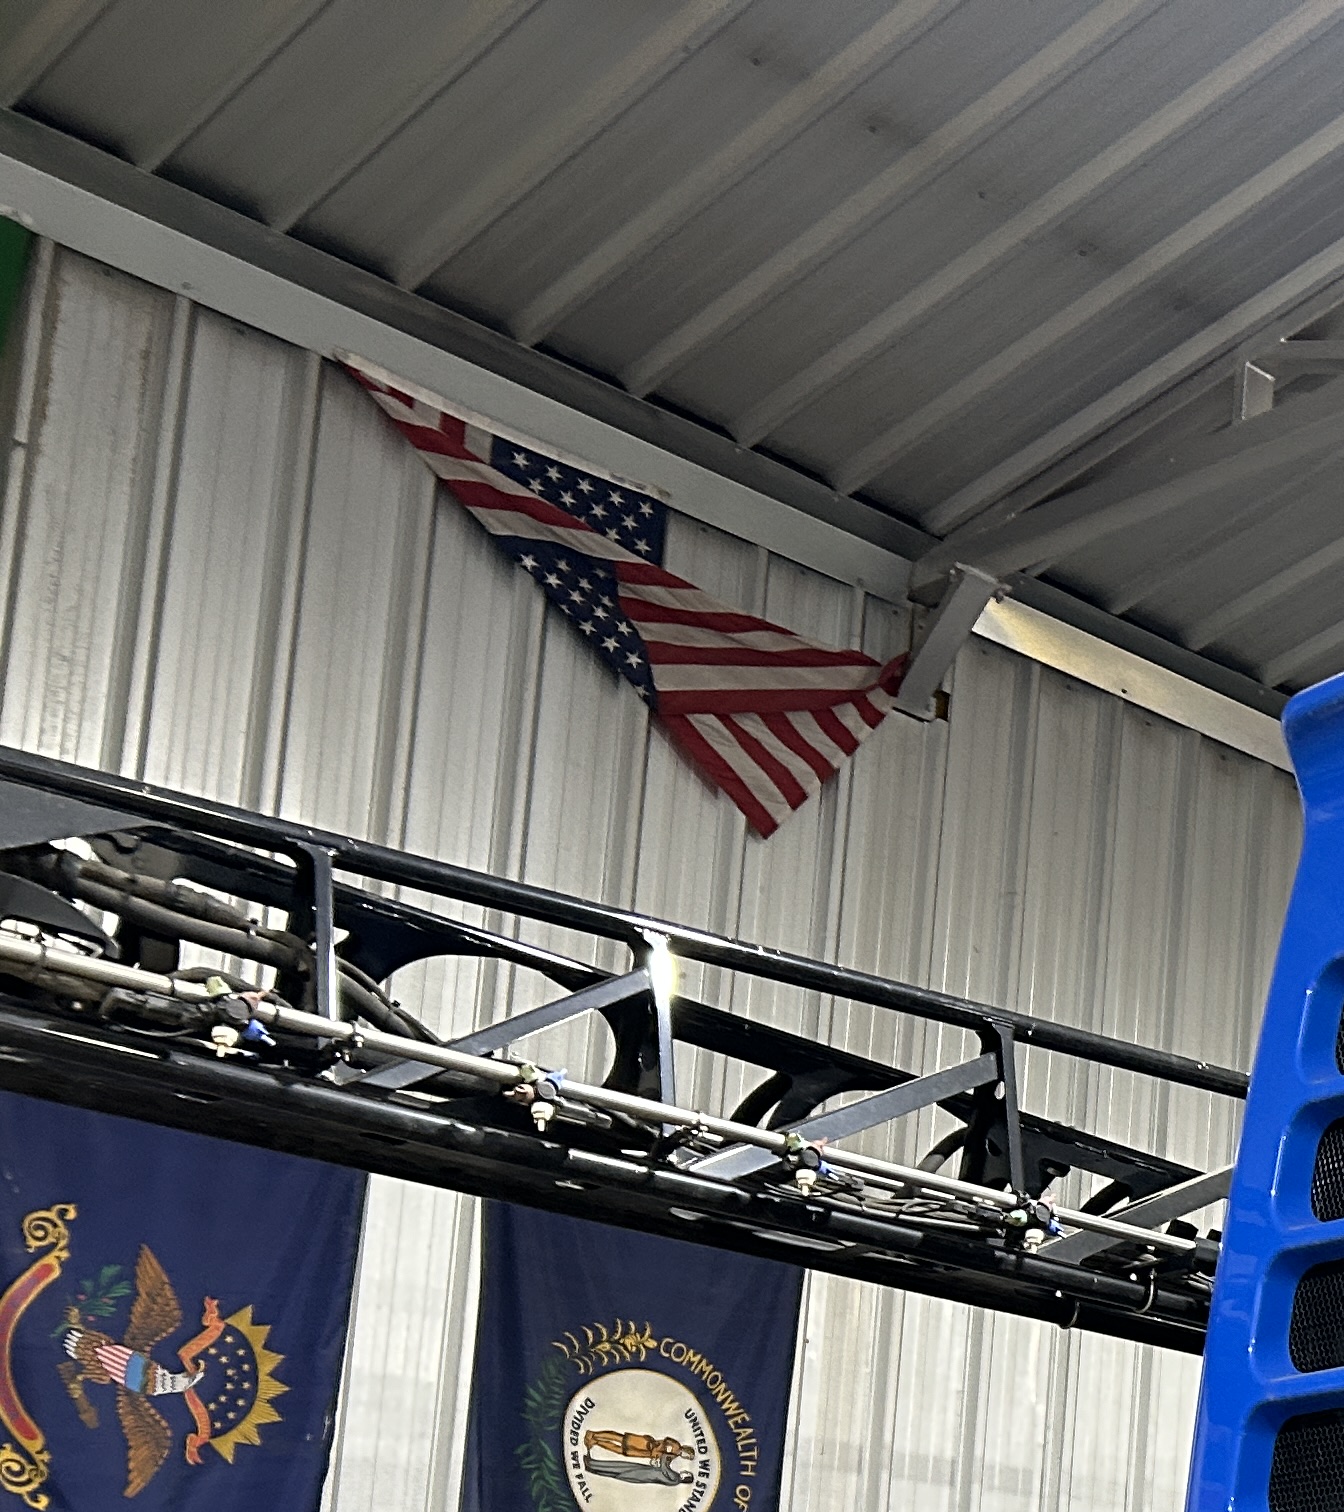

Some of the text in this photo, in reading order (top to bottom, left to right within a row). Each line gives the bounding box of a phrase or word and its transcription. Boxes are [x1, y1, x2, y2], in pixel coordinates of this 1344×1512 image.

[569, 1397, 596, 1446] DIVIDED
[659, 1337, 760, 1477] COMMONWEALTH
[733, 1483, 752, 1512] OF
[684, 1408, 709, 1455] UNITED
[698, 1459, 711, 1478] WE
[570, 1450, 581, 1470] WE
